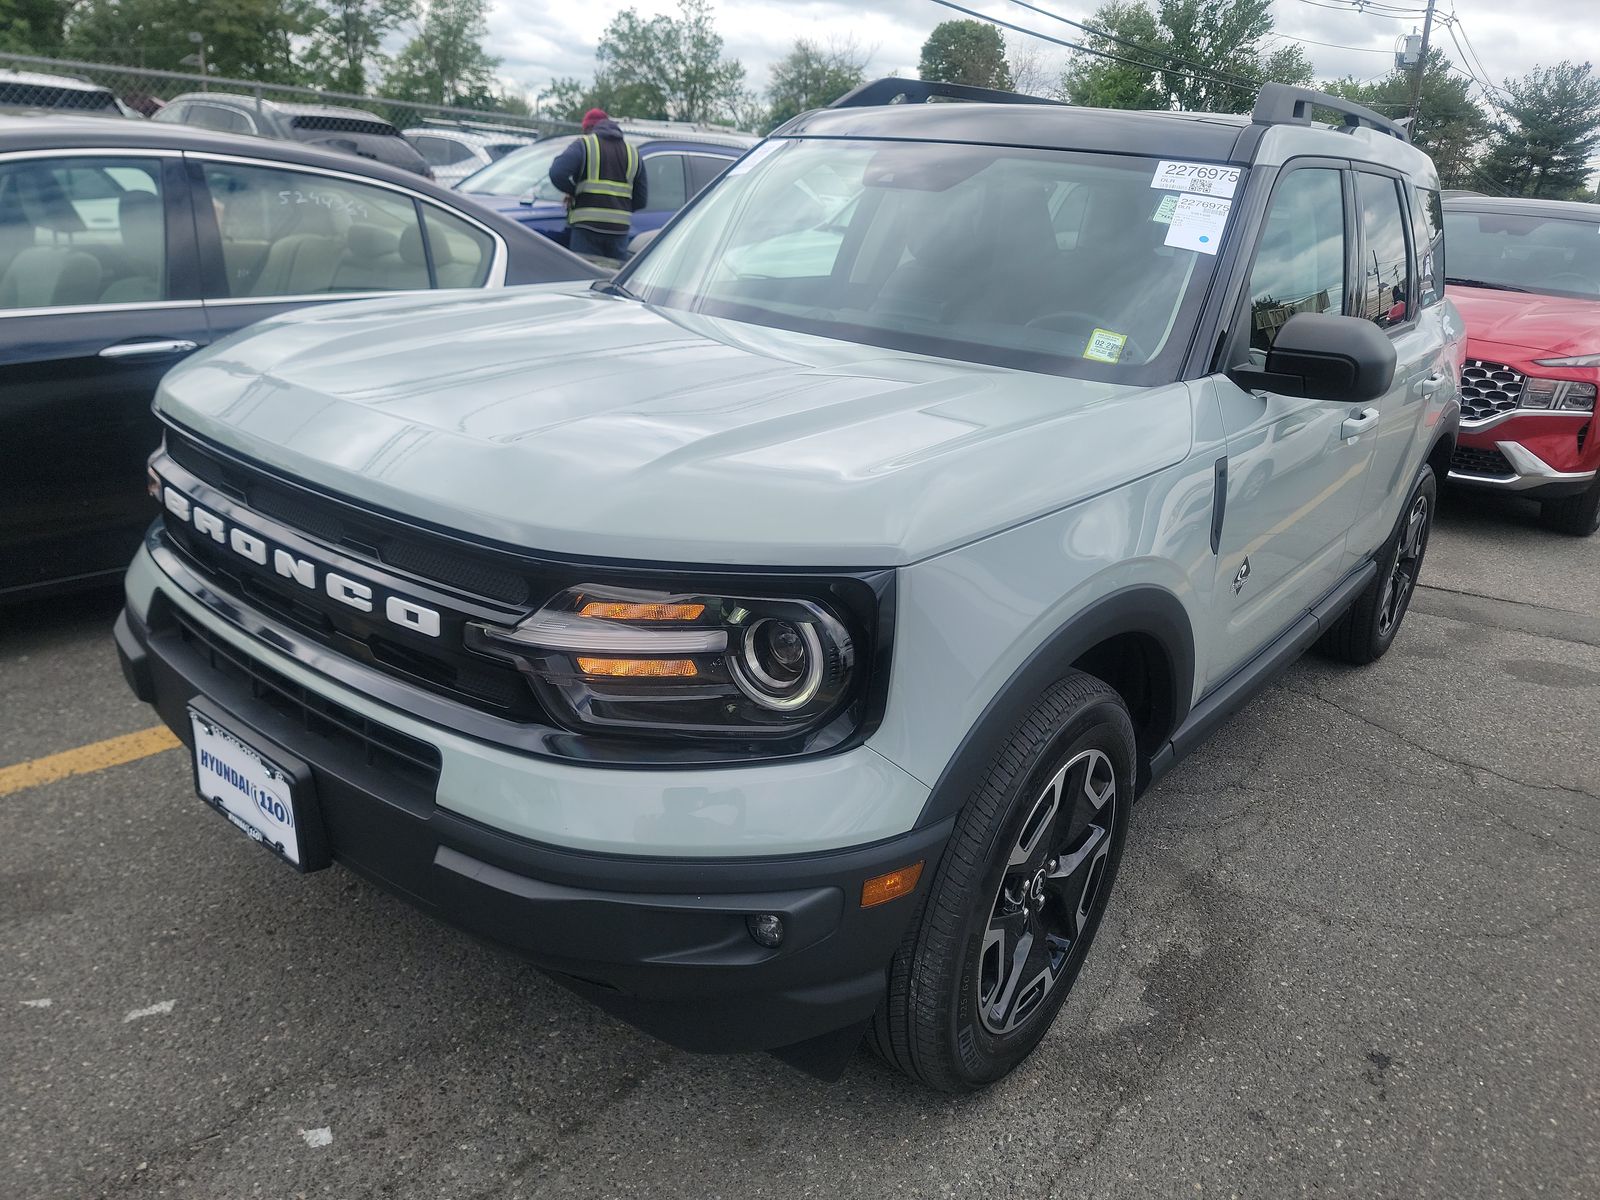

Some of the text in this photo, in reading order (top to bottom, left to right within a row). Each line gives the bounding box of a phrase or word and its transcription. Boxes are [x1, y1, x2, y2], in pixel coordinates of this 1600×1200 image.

[1165, 164, 1239, 182] 2276975
[1180, 198, 1230, 212] 2276975
[164, 486, 441, 638] BRONCO
[201, 748, 250, 796] HYUNDAI
[259, 790, 285, 823] 110
